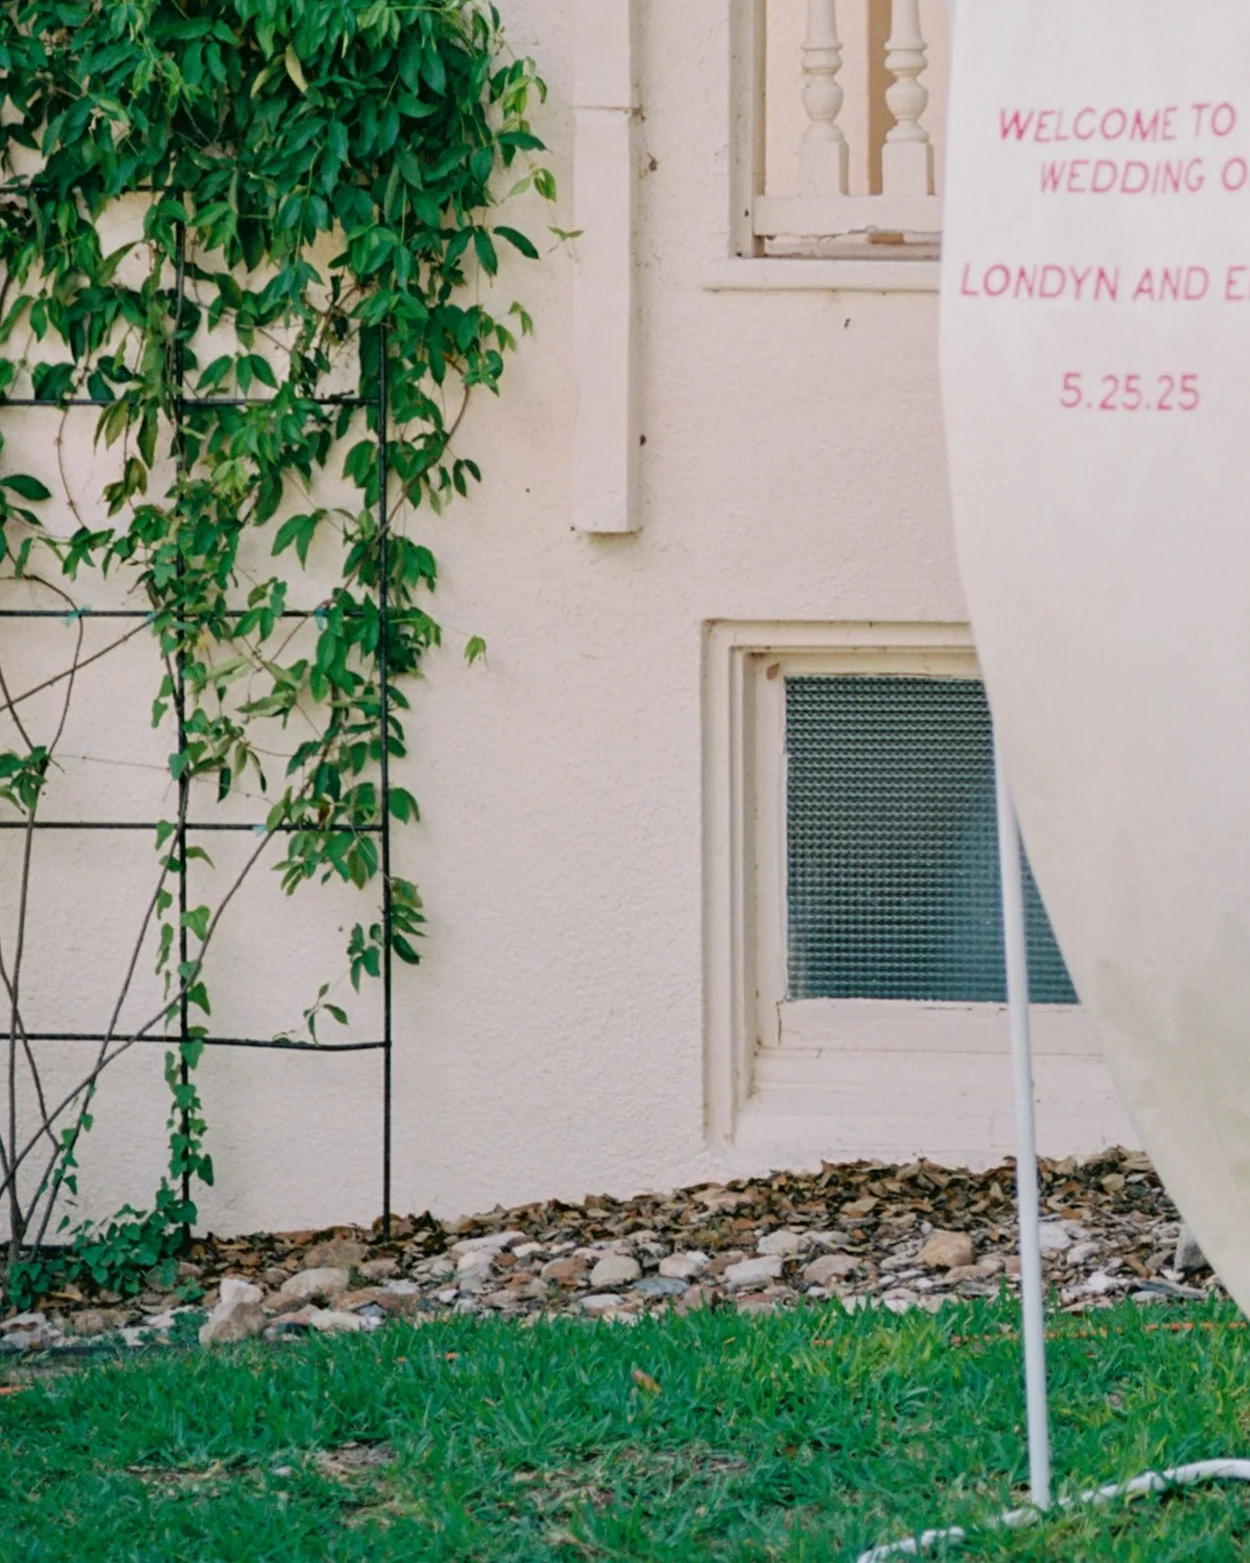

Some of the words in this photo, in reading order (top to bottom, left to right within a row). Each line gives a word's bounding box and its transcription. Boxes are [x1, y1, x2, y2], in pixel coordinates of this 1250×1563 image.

[998, 106, 1176, 143] WELCOME
[1192, 101, 1237, 138] TO
[1039, 156, 1205, 195] WEDDING
[960, 263, 1119, 301] LONDYN
[1133, 265, 1209, 301] AND
[1061, 371, 1201, 413] 5.25.25
